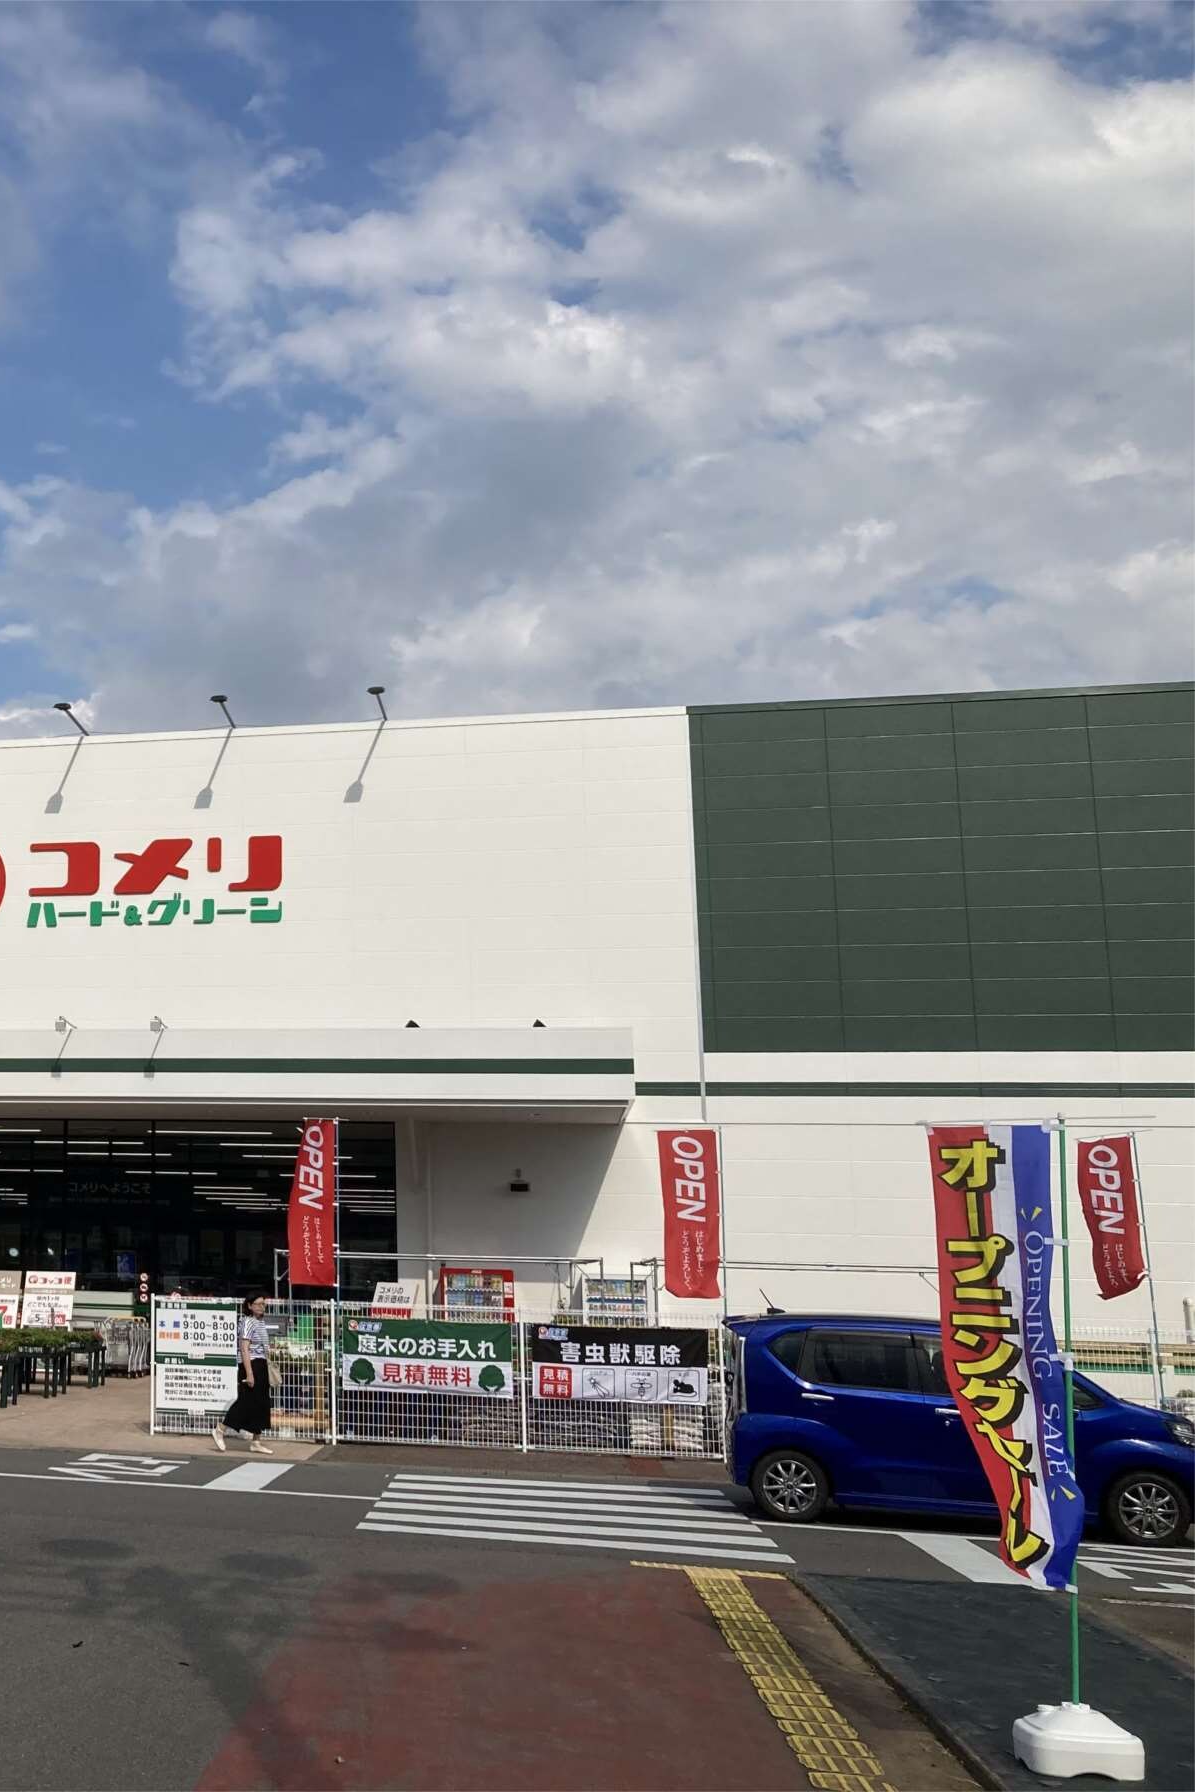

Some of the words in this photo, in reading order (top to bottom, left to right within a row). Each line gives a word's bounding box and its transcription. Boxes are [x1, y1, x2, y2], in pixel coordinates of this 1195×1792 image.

[29, 835, 283, 897] コメリ
[26, 893, 283, 928] ハード&グリーン
[298, 1125, 324, 1210] OPEN
[671, 1136, 706, 1223] OPEN
[1088, 1145, 1125, 1235] OPEN
[379, 1286, 404, 1295] コメリの
[357, 1334, 497, 1360] 庭木のお手入れ
[560, 1341, 681, 1366] 害虫獣駆除
[1023, 1230, 1053, 1381] OPENING
[1041, 1403, 1070, 1477] SALE
[382, 1363, 472, 1388] 見積無料
[543, 1369, 569, 1382] 見積
[543, 1383, 569, 1396] 無料
